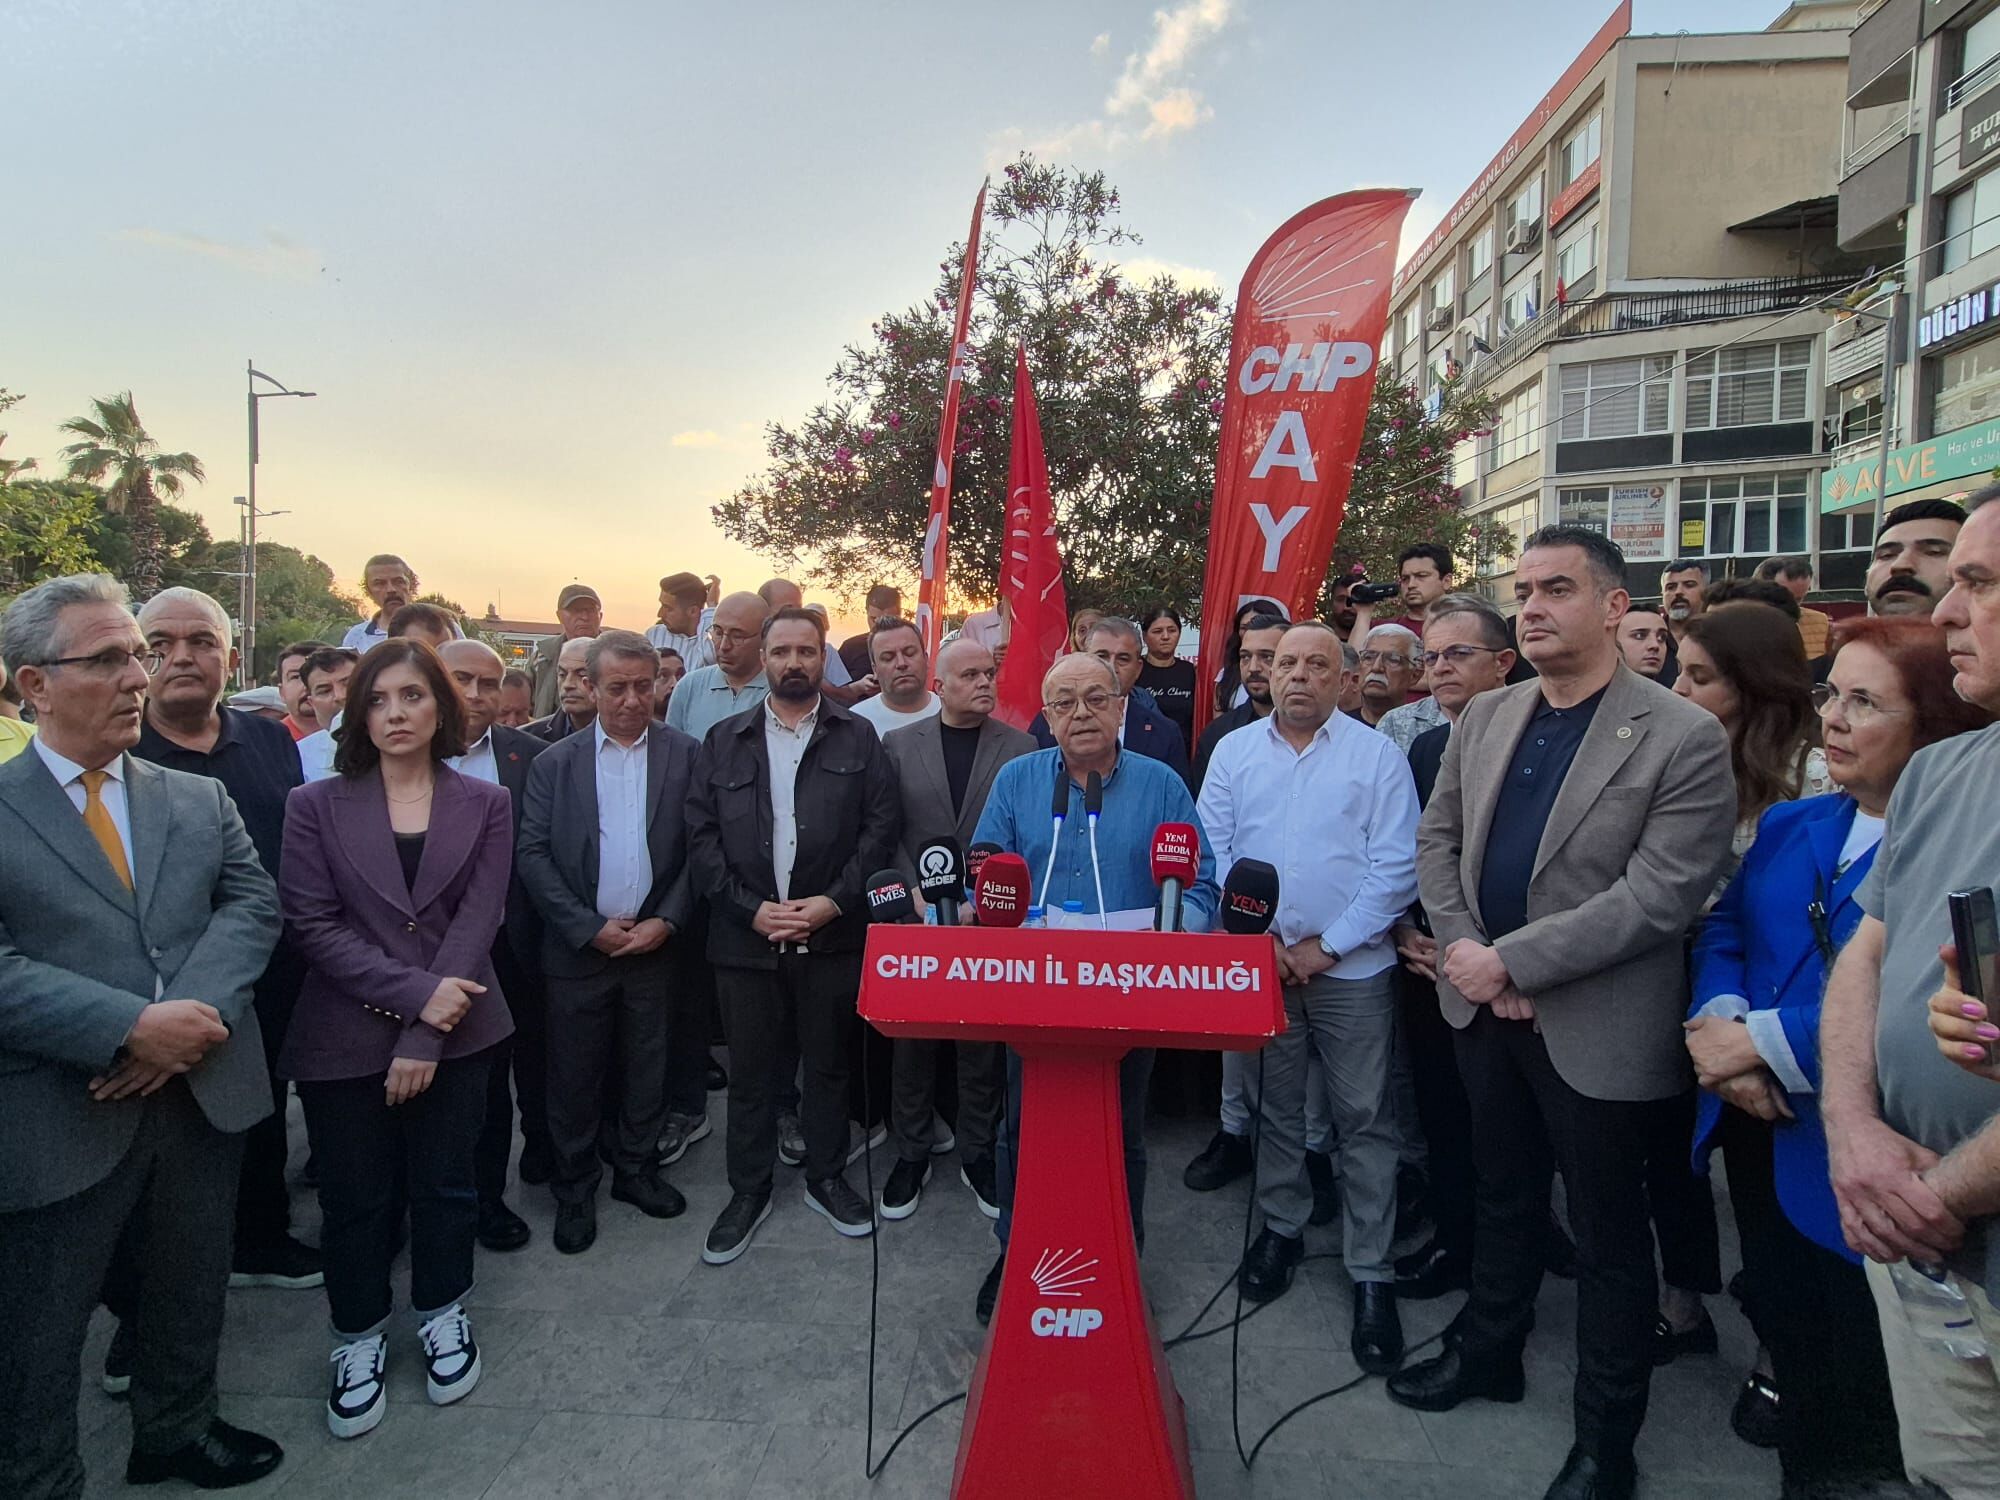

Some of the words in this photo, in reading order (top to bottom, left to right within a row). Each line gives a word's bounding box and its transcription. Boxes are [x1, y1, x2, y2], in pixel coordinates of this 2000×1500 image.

[1407, 242, 1433, 278] AYDIN
[1919, 290, 1986, 348] DÜĞÜN
[1238, 341, 1373, 396] CHP
[1156, 843, 1191, 856] KIROBA
[921, 874, 957, 889] HEDEF
[982, 880, 1017, 895] Ajans
[867, 887, 907, 908] TIMES
[981, 896, 1016, 911] Aydın
[876, 954, 939, 980] CHP
[946, 957, 1035, 985] AYDIN
[1045, 954, 1069, 986] İL
[1077, 960, 1261, 994] BAŞKANLIĞI
[1031, 1307, 1103, 1338] CHP
